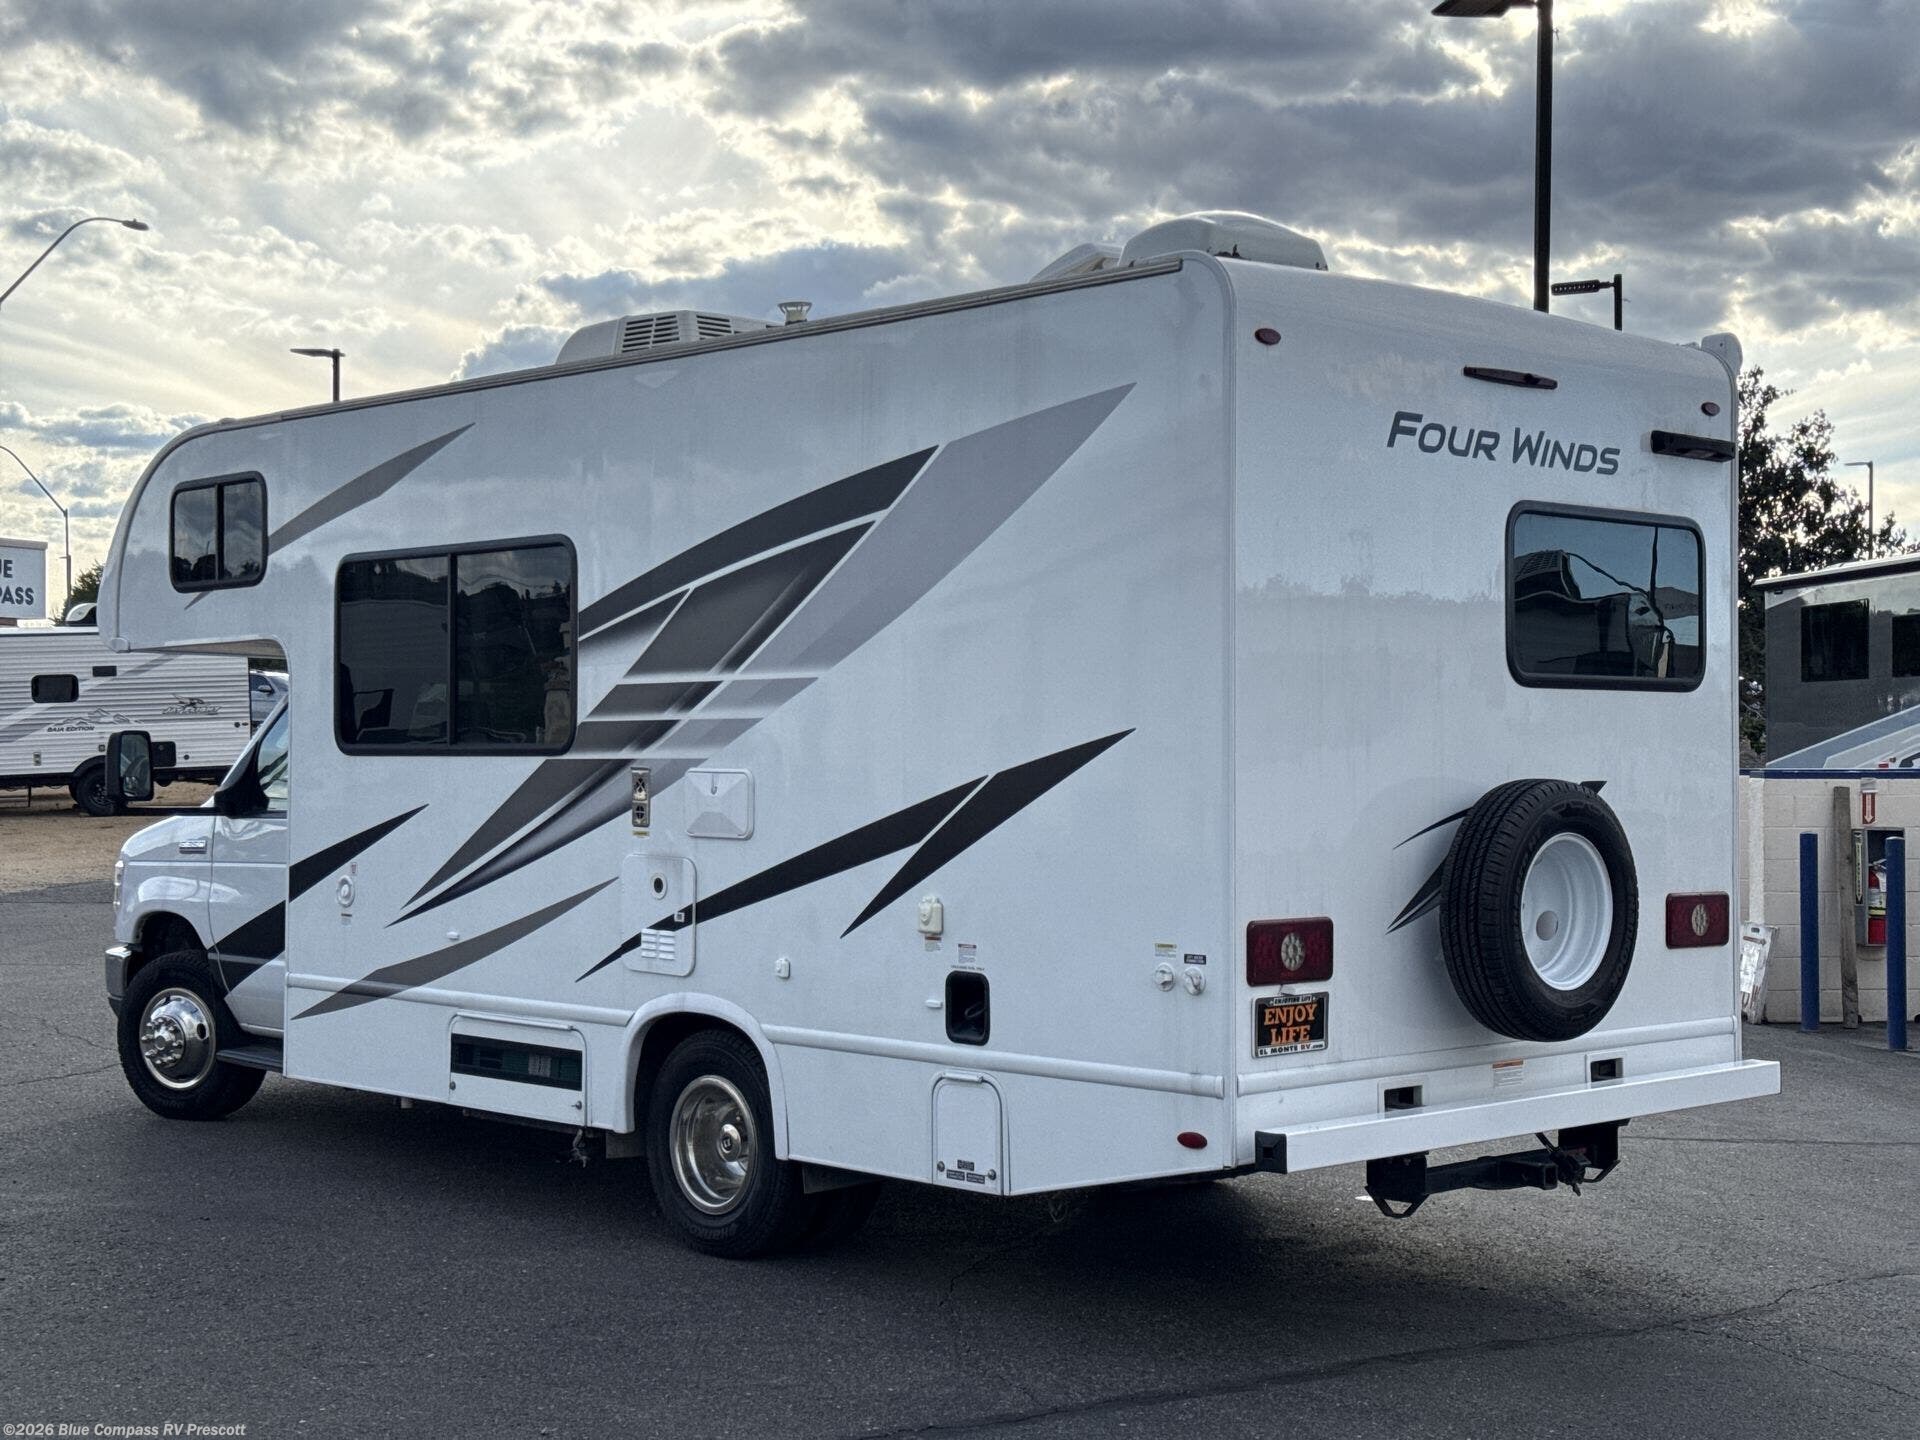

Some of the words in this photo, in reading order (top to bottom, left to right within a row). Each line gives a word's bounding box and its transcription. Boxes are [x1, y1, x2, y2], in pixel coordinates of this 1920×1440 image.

[1387, 411, 1500, 461] FOUR
[1512, 427, 1621, 475] WINDS
[1264, 1004, 1317, 1026] ENJOY
[1270, 1025, 1311, 1046] LIFE
[1271, 1045, 1298, 1054] MONTE
